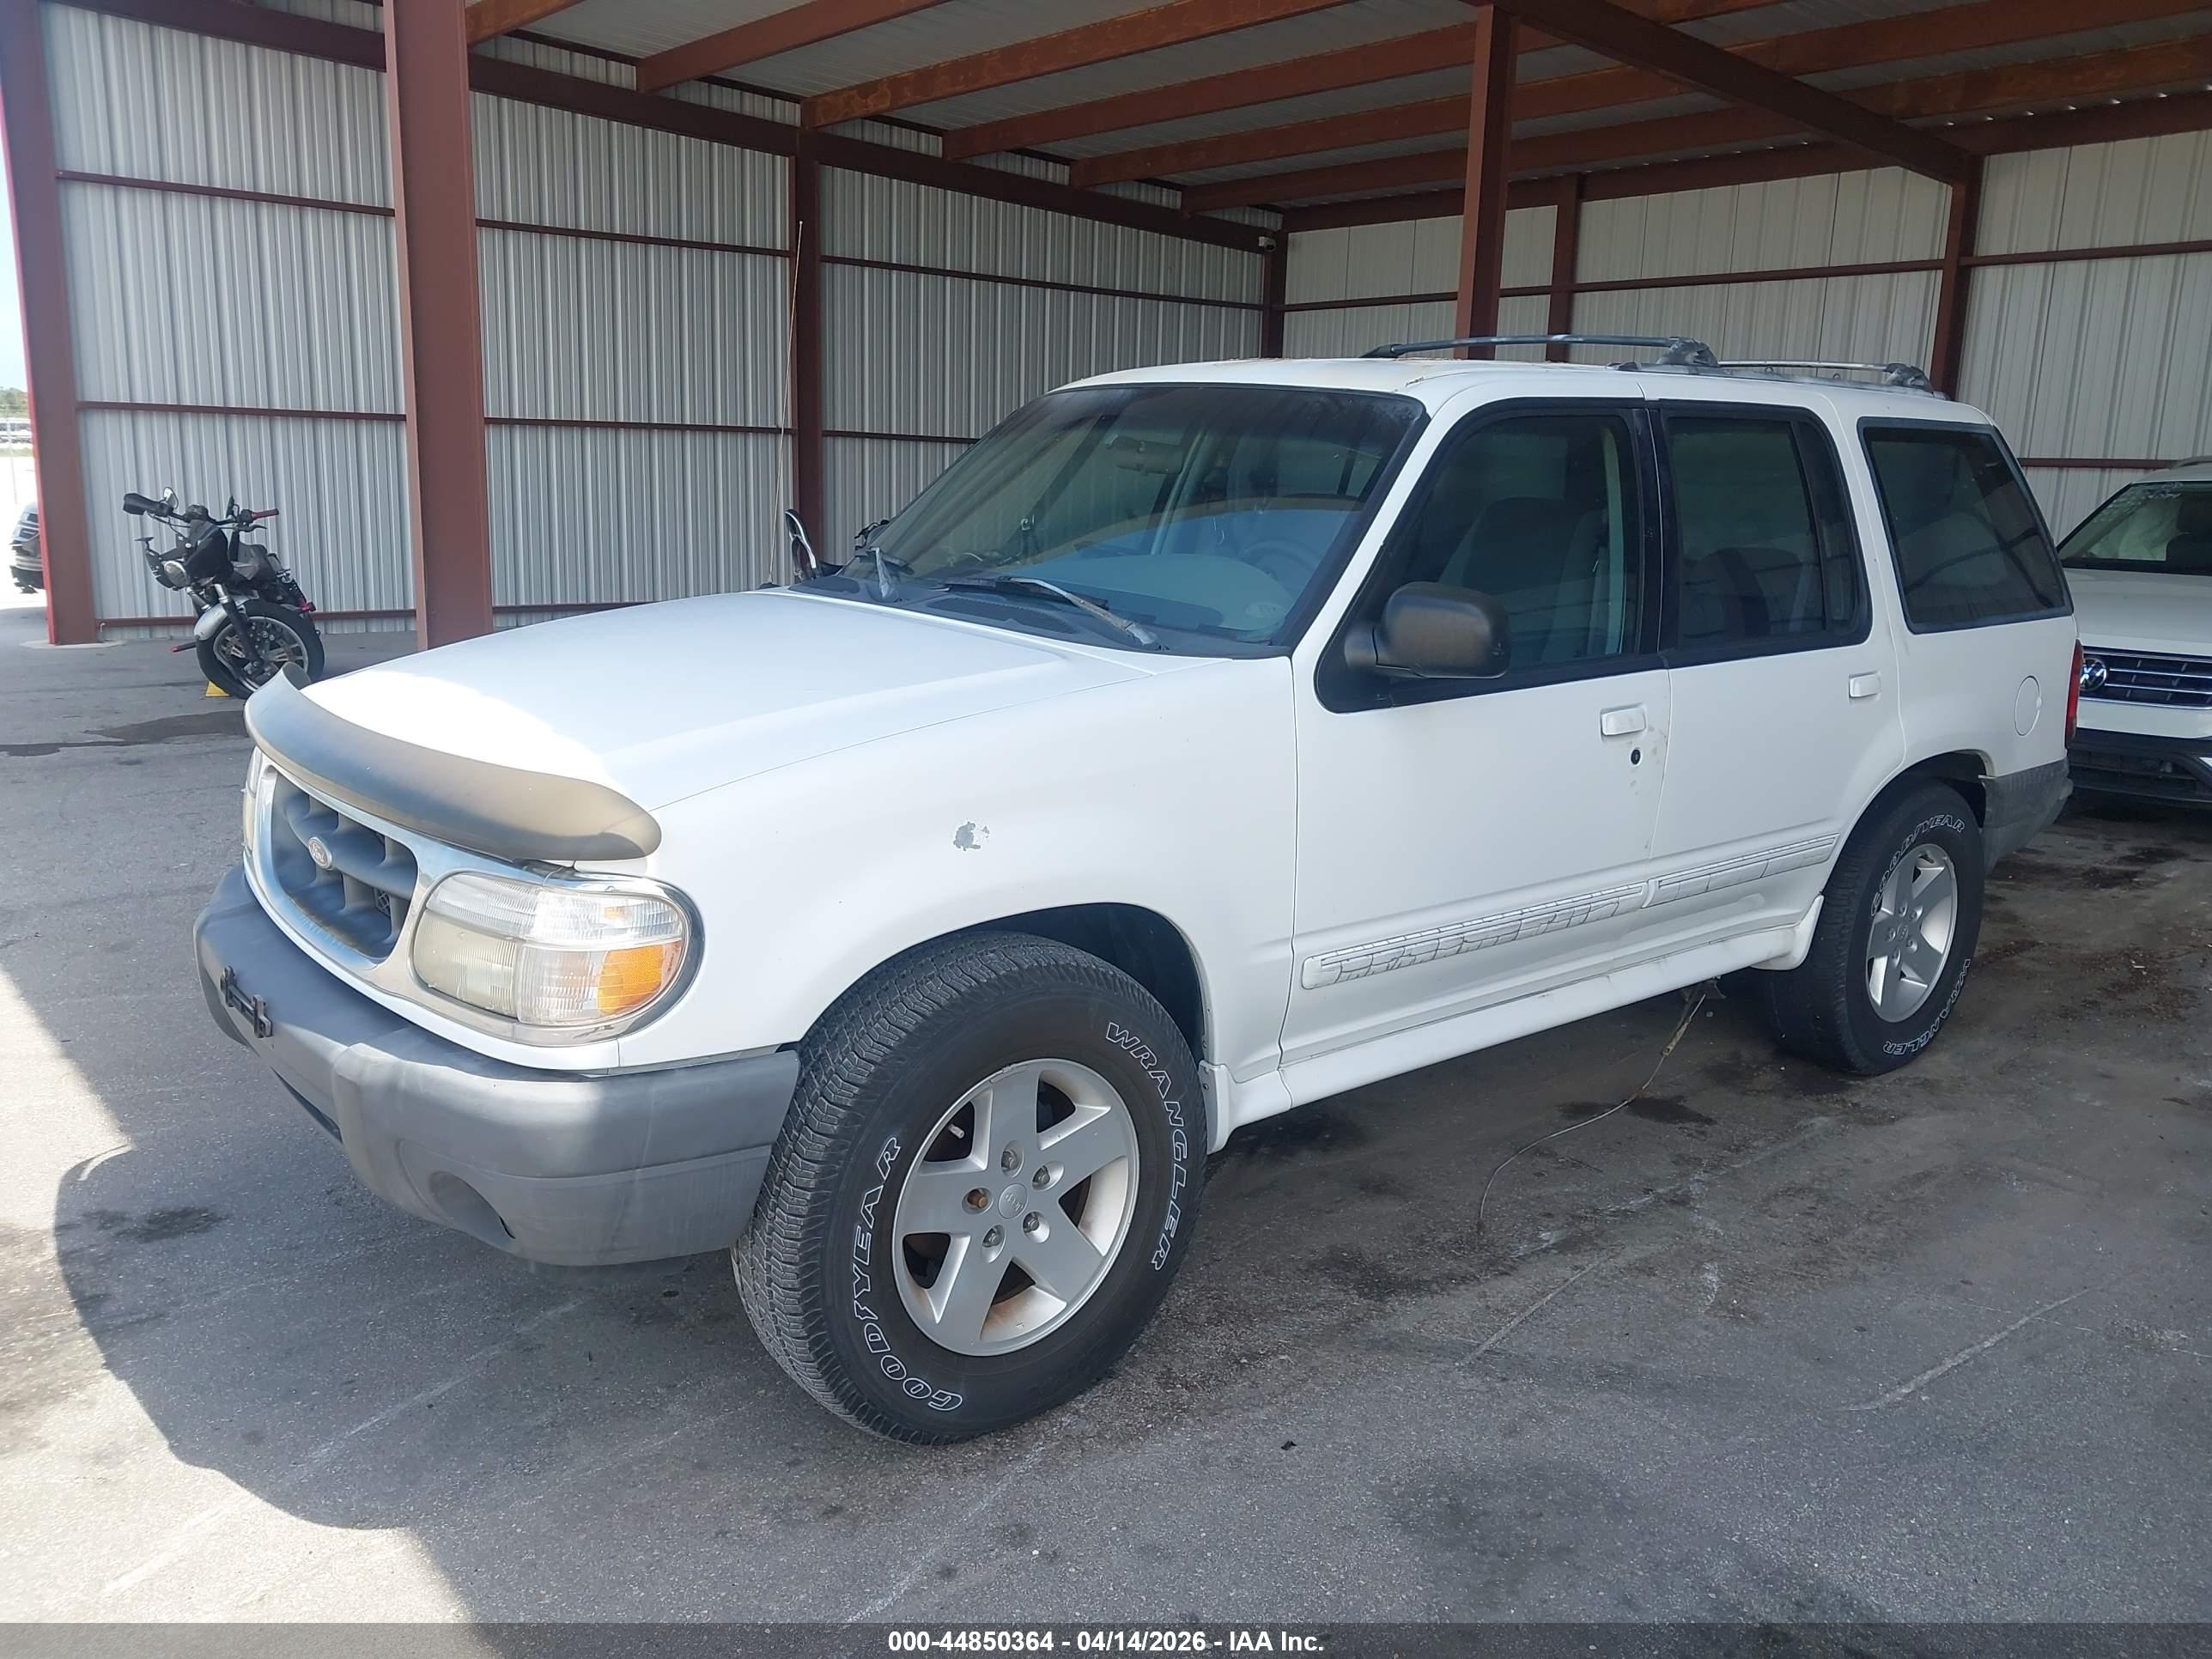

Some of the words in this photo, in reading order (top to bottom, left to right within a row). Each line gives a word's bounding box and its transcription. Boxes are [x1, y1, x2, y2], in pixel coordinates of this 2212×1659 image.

[1871, 814, 1966, 917] GOODYEAR
[1882, 958, 1971, 1055] WRANGLER
[1105, 1022, 1188, 1271] WRANGLER
[853, 1137, 963, 1411] GOODYEAR
